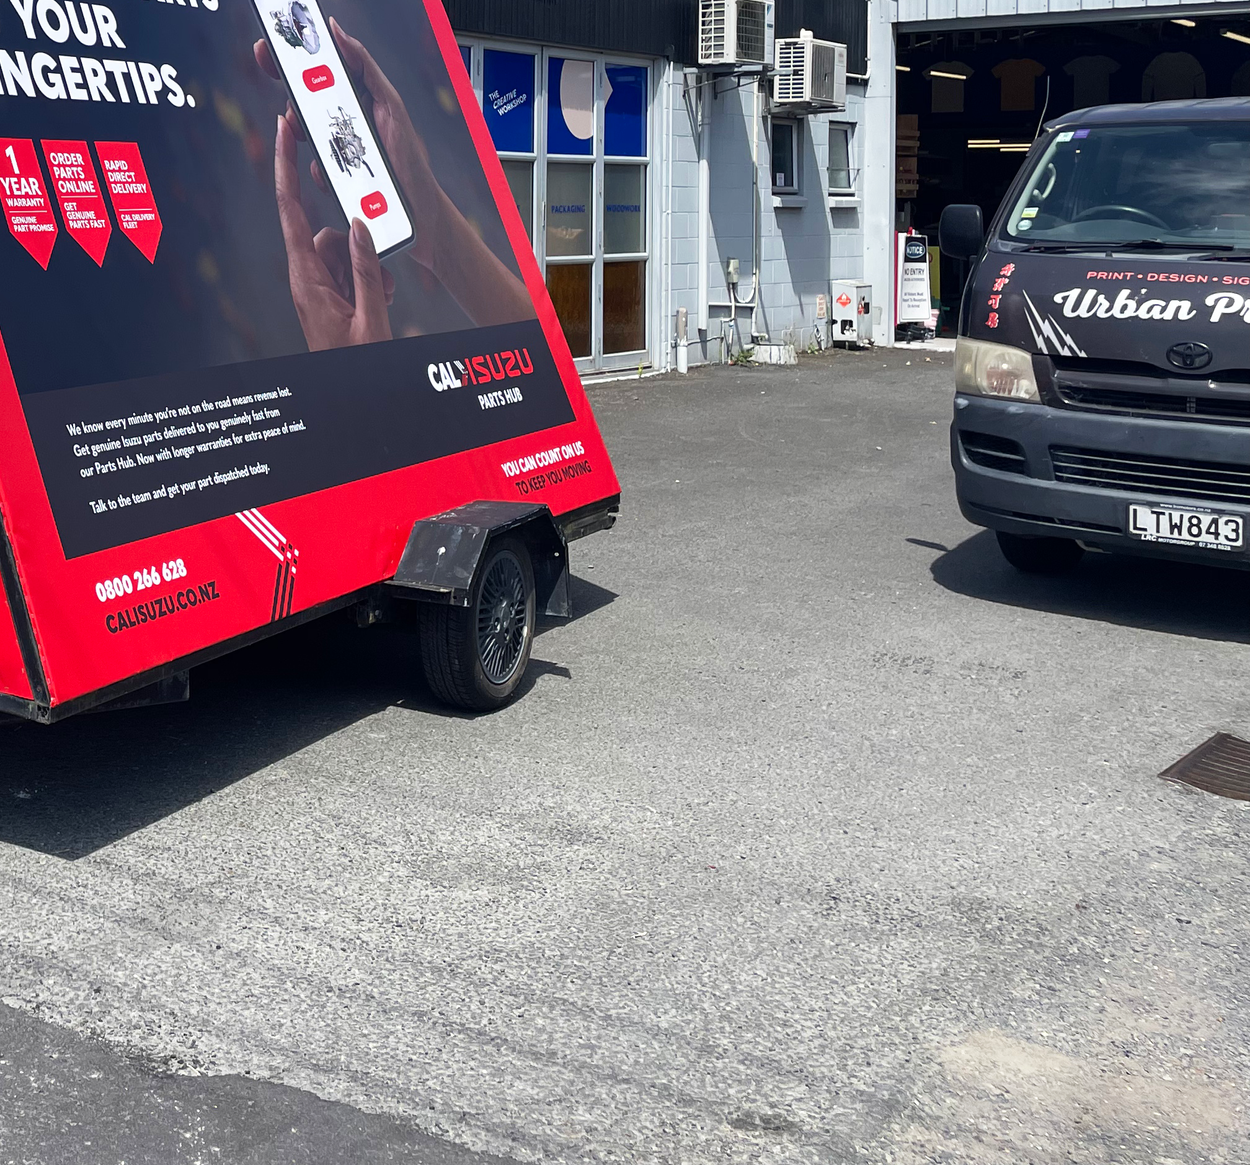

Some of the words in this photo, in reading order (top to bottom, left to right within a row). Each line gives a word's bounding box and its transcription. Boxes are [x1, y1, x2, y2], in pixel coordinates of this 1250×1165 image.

[489, 90, 500, 101] THE
[493, 89, 516, 109] CREATIVE
[498, 94, 527, 116] WORKSHOP
[5, 146, 20, 174] 1
[50, 153, 84, 165] ORDER
[104, 160, 128, 170] RAPID
[53, 167, 84, 179] PARTS
[108, 172, 135, 182] DIRECT
[0, 178, 42, 195] YEAR
[58, 181, 95, 193] ONLINE
[111, 184, 147, 194] DELIVERY
[6, 198, 44, 207] WARRANTY
[64, 202, 77, 210] GET
[552, 205, 585, 213] PACKAGING
[12, 216, 37, 224] GENUINE
[67, 211, 96, 220] GENUINE
[69, 220, 90, 229] PARTS
[90, 220, 105, 228] FAST
[1087, 271, 1134, 280] PRINT
[1146, 273, 1208, 283] DESIGN
[1222, 276, 1250, 285] SIG
[1054, 288, 1196, 320] Urban
[1205, 292, 1250, 323] Pr
[428, 361, 462, 392] CAL
[465, 348, 534, 385] ISUZU
[478, 390, 504, 410] PARTS
[504, 387, 523, 404] HUB
[66, 424, 81, 436] We
[81, 421, 104, 434] know
[105, 418, 126, 430] every
[128, 413, 153, 425] minute
[154, 407, 177, 423] you're
[178, 405, 191, 416] not
[192, 404, 201, 414] on
[201, 400, 214, 412] the
[216, 396, 232, 410] road
[232, 396, 253, 406] means
[254, 390, 278, 402] revenue
[277, 386, 292, 398] lost.
[73, 443, 90, 457] Get
[91, 438, 121, 456] genuine
[121, 435, 142, 448] Isuzu
[142, 430, 163, 446] parts
[163, 422, 196, 440] delivered
[197, 422, 206, 432] to
[206, 420, 220, 433] you
[220, 412, 251, 430] genuinely
[252, 410, 265, 421] fast
[264, 408, 280, 418] from
[80, 467, 94, 478] our
[94, 461, 117, 474] Parts
[116, 456, 137, 470] Hub.
[136, 453, 155, 466] Now
[155, 448, 172, 461] with
[172, 445, 195, 458] longer
[196, 436, 232, 453] warranties
[232, 433, 243, 445] for
[244, 430, 262, 442] extra
[263, 427, 281, 441] peace
[282, 422, 289, 434] of
[288, 419, 306, 433] mind.
[501, 460, 520, 477] YOU
[518, 454, 538, 472] CAN
[536, 447, 562, 468] COUNT
[561, 444, 575, 460] ON
[573, 441, 584, 456] US
[516, 480, 529, 495] TO
[527, 474, 546, 492] KEEP
[545, 469, 563, 486] YOU
[562, 460, 592, 481] MOVING
[89, 499, 108, 514] Talk
[107, 498, 117, 510] to
[117, 494, 132, 507] the
[132, 492, 152, 504] team
[152, 484, 167, 499] and
[167, 483, 180, 498] get
[180, 481, 196, 495] your
[197, 475, 213, 491] part
[214, 465, 249, 485] dispatched
[249, 462, 270, 475] today.
[1133, 508, 1240, 542] LTW843
[95, 575, 133, 603] 0800
[134, 566, 161, 591] 266
[162, 558, 187, 582] 628
[105, 580, 220, 634] CALISUZU.CO.NZ
